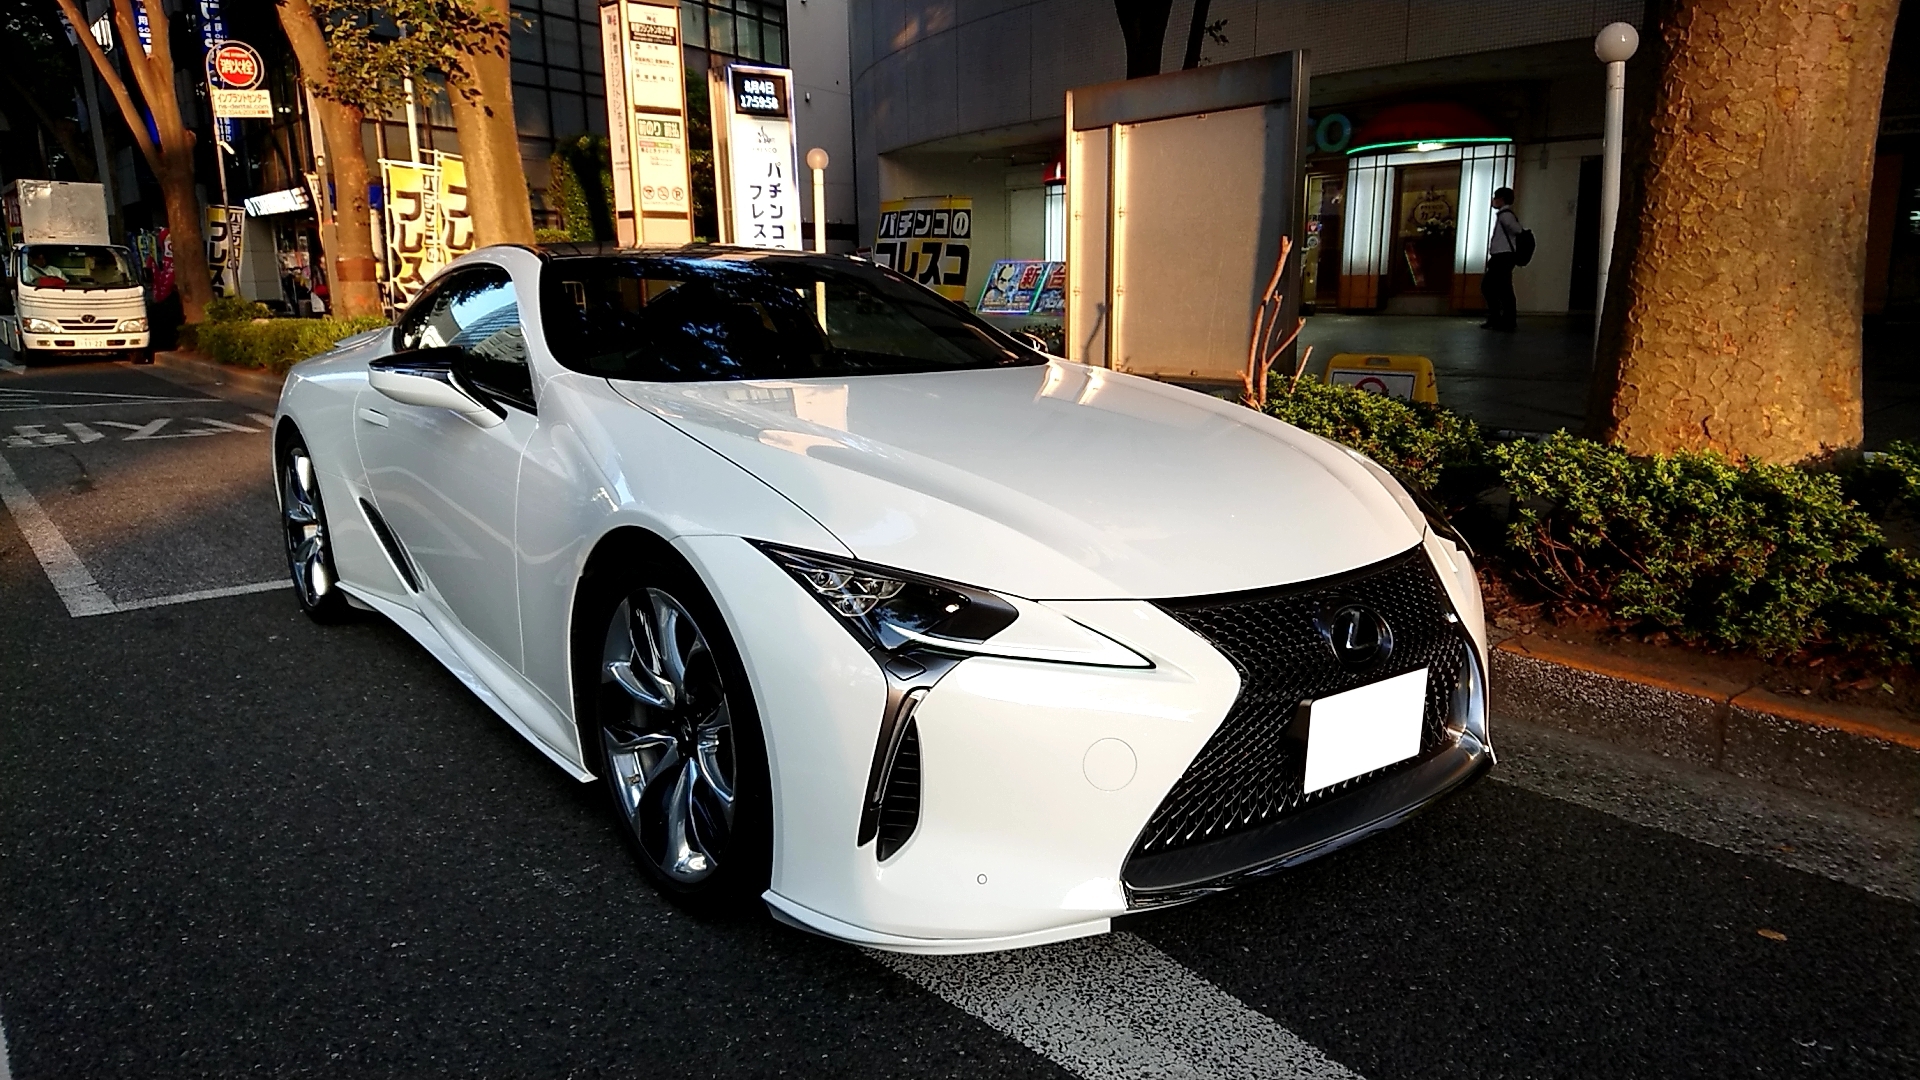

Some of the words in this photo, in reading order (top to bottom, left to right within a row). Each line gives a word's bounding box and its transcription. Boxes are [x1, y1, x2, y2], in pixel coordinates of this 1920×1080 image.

[220, 59, 254, 75] 消火栓
[447, 185, 473, 261] フレ
[750, 185, 767, 247] フレス
[879, 211, 970, 237] パチンコの
[876, 241, 970, 286] フレスコ
